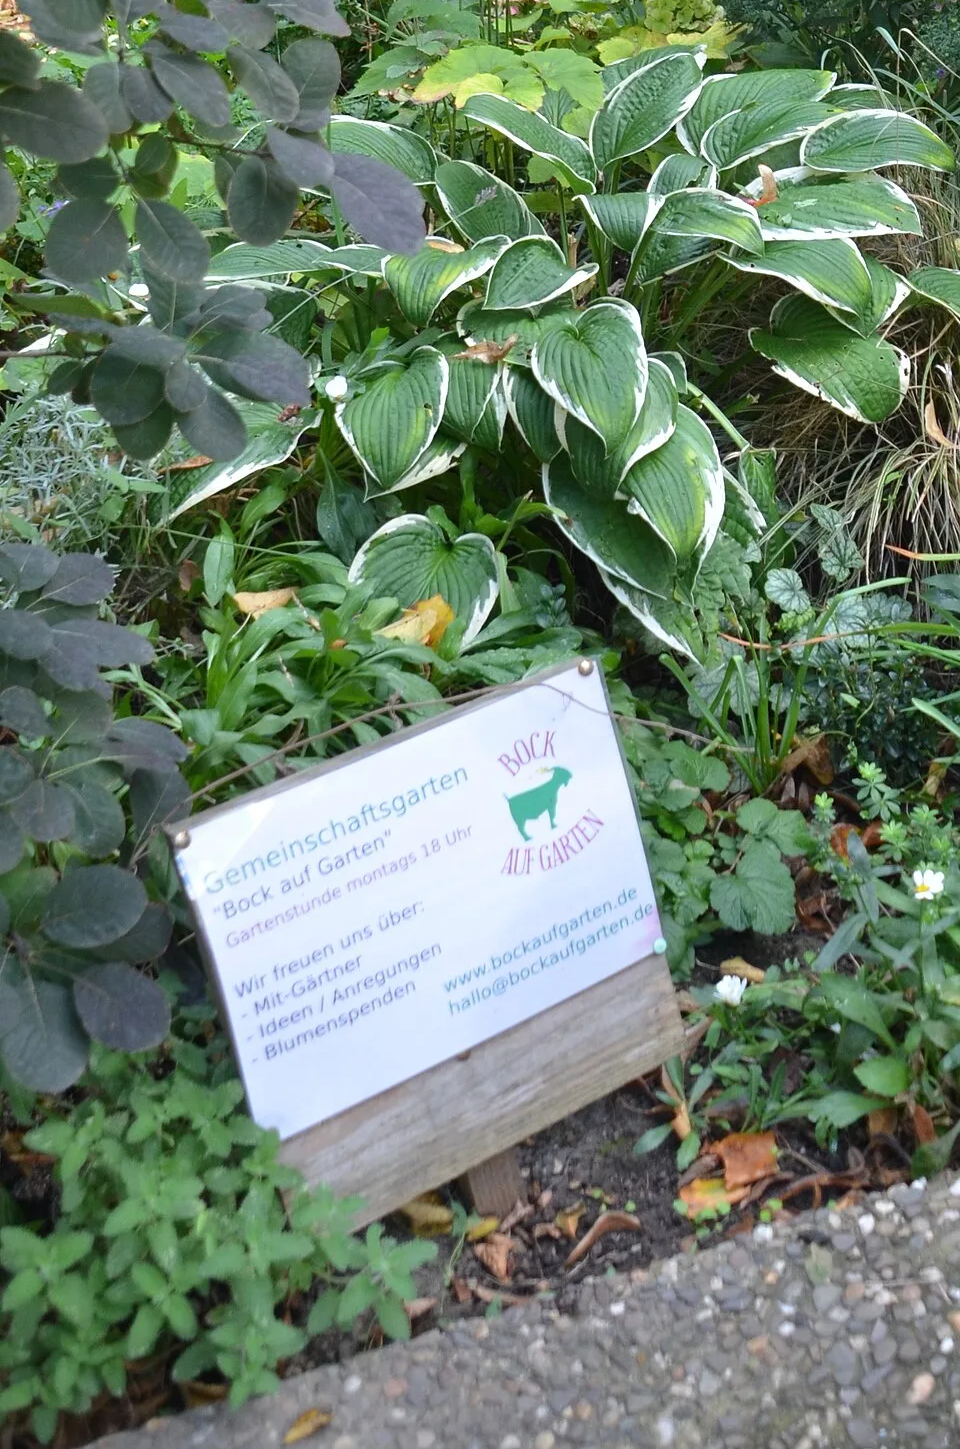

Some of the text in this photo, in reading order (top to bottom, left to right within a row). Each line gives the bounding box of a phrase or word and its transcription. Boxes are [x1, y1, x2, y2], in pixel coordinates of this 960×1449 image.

[497, 730, 557, 777] BOCK
[204, 765, 469, 895] Gemeinschaftsgarten
[280, 864, 313, 894] auf
[500, 808, 605, 876] AUF GARTEN
[225, 824, 473, 949] Gartenstunde montags 18 Uhr
[234, 899, 426, 999] Wir freuen uns über:
[253, 953, 363, 1017] Mit-Gärtner
[443, 886, 638, 993] www.bockaufgarten.de
[448, 902, 654, 1016] hallo@bockaufgarten.de
[259, 1004, 314, 1039] Ideen
[332, 941, 443, 1006] Anregungen
[264, 979, 417, 1061] Blumenspenden
